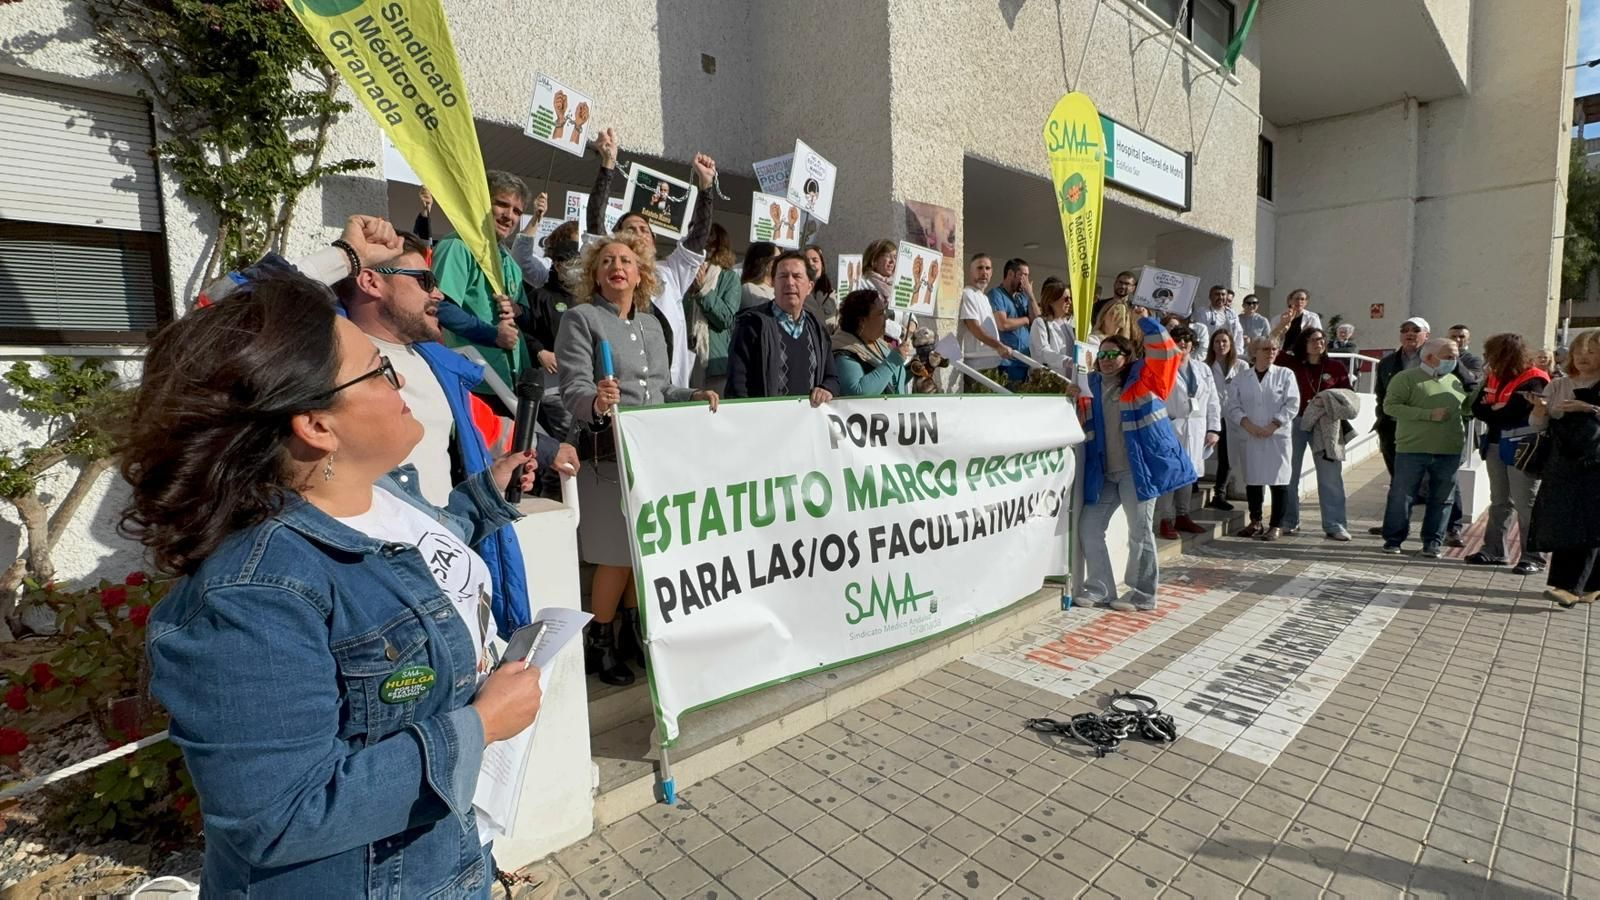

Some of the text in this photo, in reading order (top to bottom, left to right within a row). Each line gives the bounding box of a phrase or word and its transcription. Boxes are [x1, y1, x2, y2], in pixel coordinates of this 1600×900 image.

[328, 29, 403, 127] Granada
[354, 15, 439, 131] Médico de
[381, 2, 457, 108] Sindicato
[1049, 119, 1099, 157] SMA
[1116, 140, 1184, 180] Hospital General de Motril
[1116, 159, 1141, 177] Edificio Sur
[1074, 215, 1088, 261] Médico
[1081, 262, 1091, 279] de
[829, 411, 939, 450] POR UN
[636, 447, 1065, 557] ESTATUTO MARCO PROPIO
[653, 555, 742, 624] PARA
[747, 529, 861, 589] LAS/OS
[844, 569, 934, 625] SMA
[849, 626, 883, 641] Sindicato
[909, 617, 942, 636] Granada
[385, 674, 434, 689] HUELGA
[1183, 692, 1263, 727] EN
[1239, 652, 1309, 675] EL
